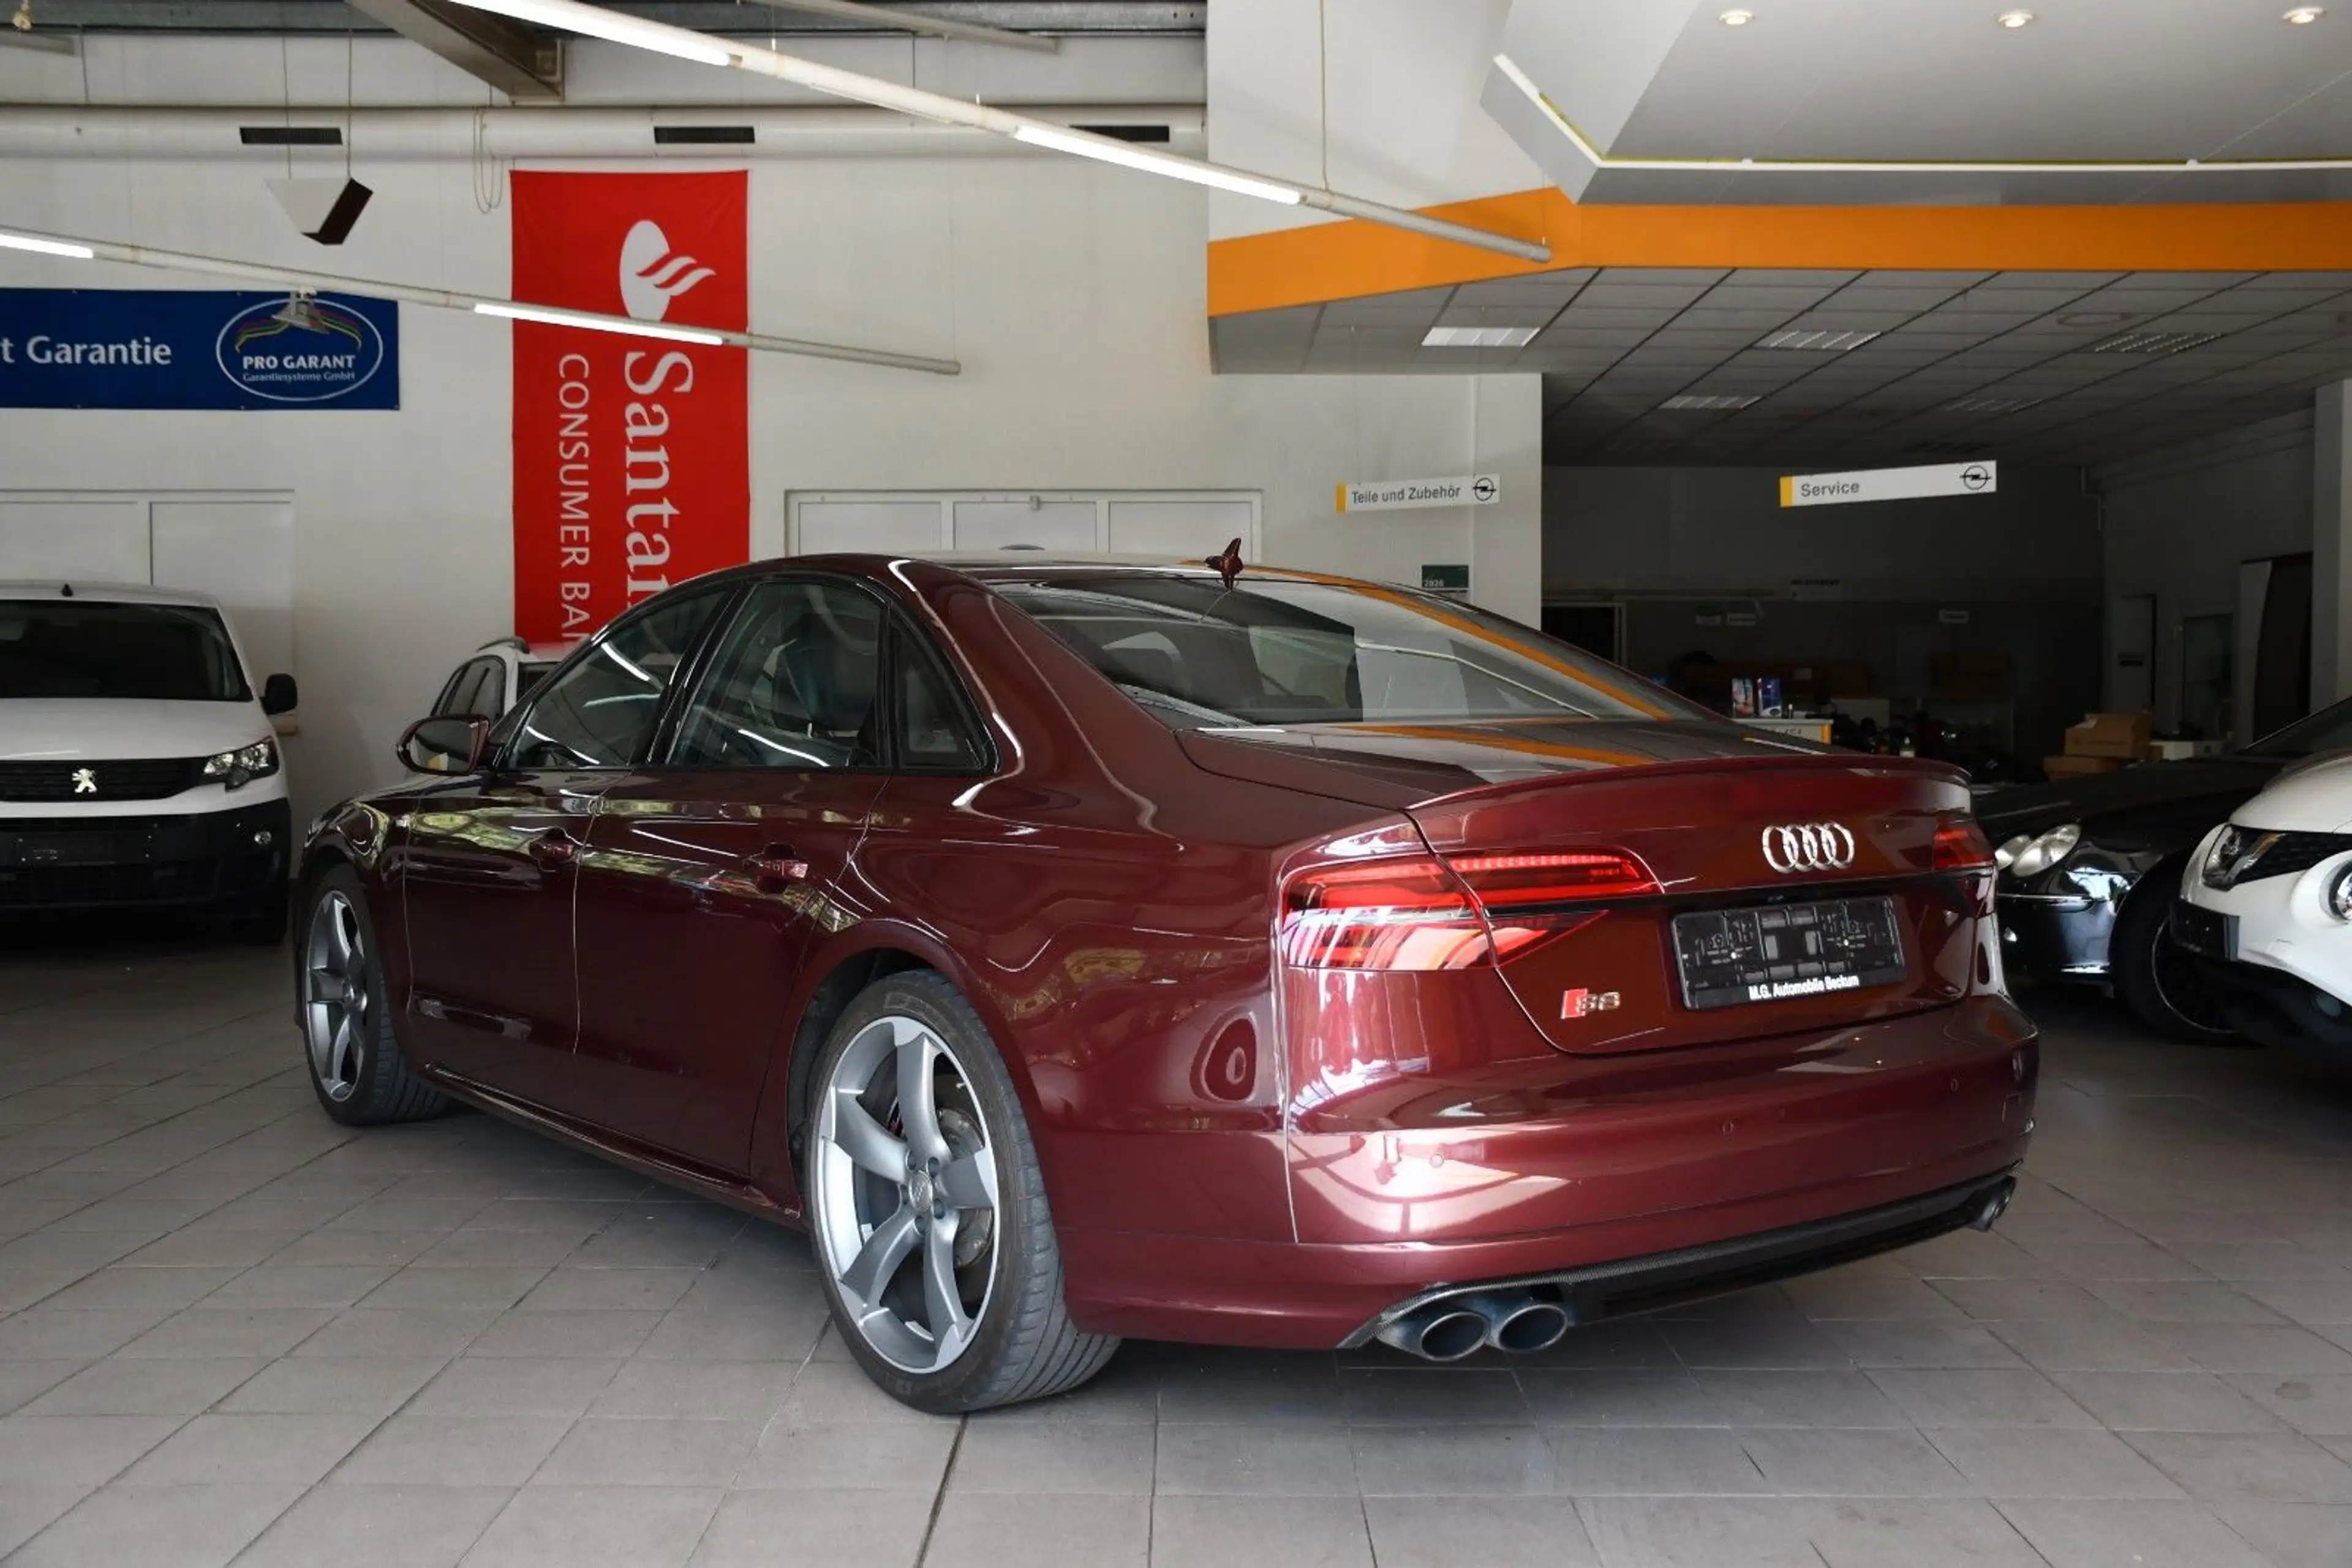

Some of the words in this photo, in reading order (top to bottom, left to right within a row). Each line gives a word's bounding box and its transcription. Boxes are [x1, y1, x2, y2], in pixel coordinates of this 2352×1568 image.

[26, 335, 172, 363] Garantie
[243, 355, 278, 369] PRO
[283, 355, 355, 369] GARANT
[243, 372, 321, 384] Garantiesysteme
[323, 372, 355, 382] GmbH
[558, 353, 589, 567] CONSUMER
[1352, 491, 1378, 503] Teile
[1382, 489, 1404, 501] und
[1408, 486, 1461, 500] Zubehör
[1801, 482, 1860, 497] Service
[1749, 985, 1772, 1000] M.G.
[1773, 978, 1825, 997] Automobile
